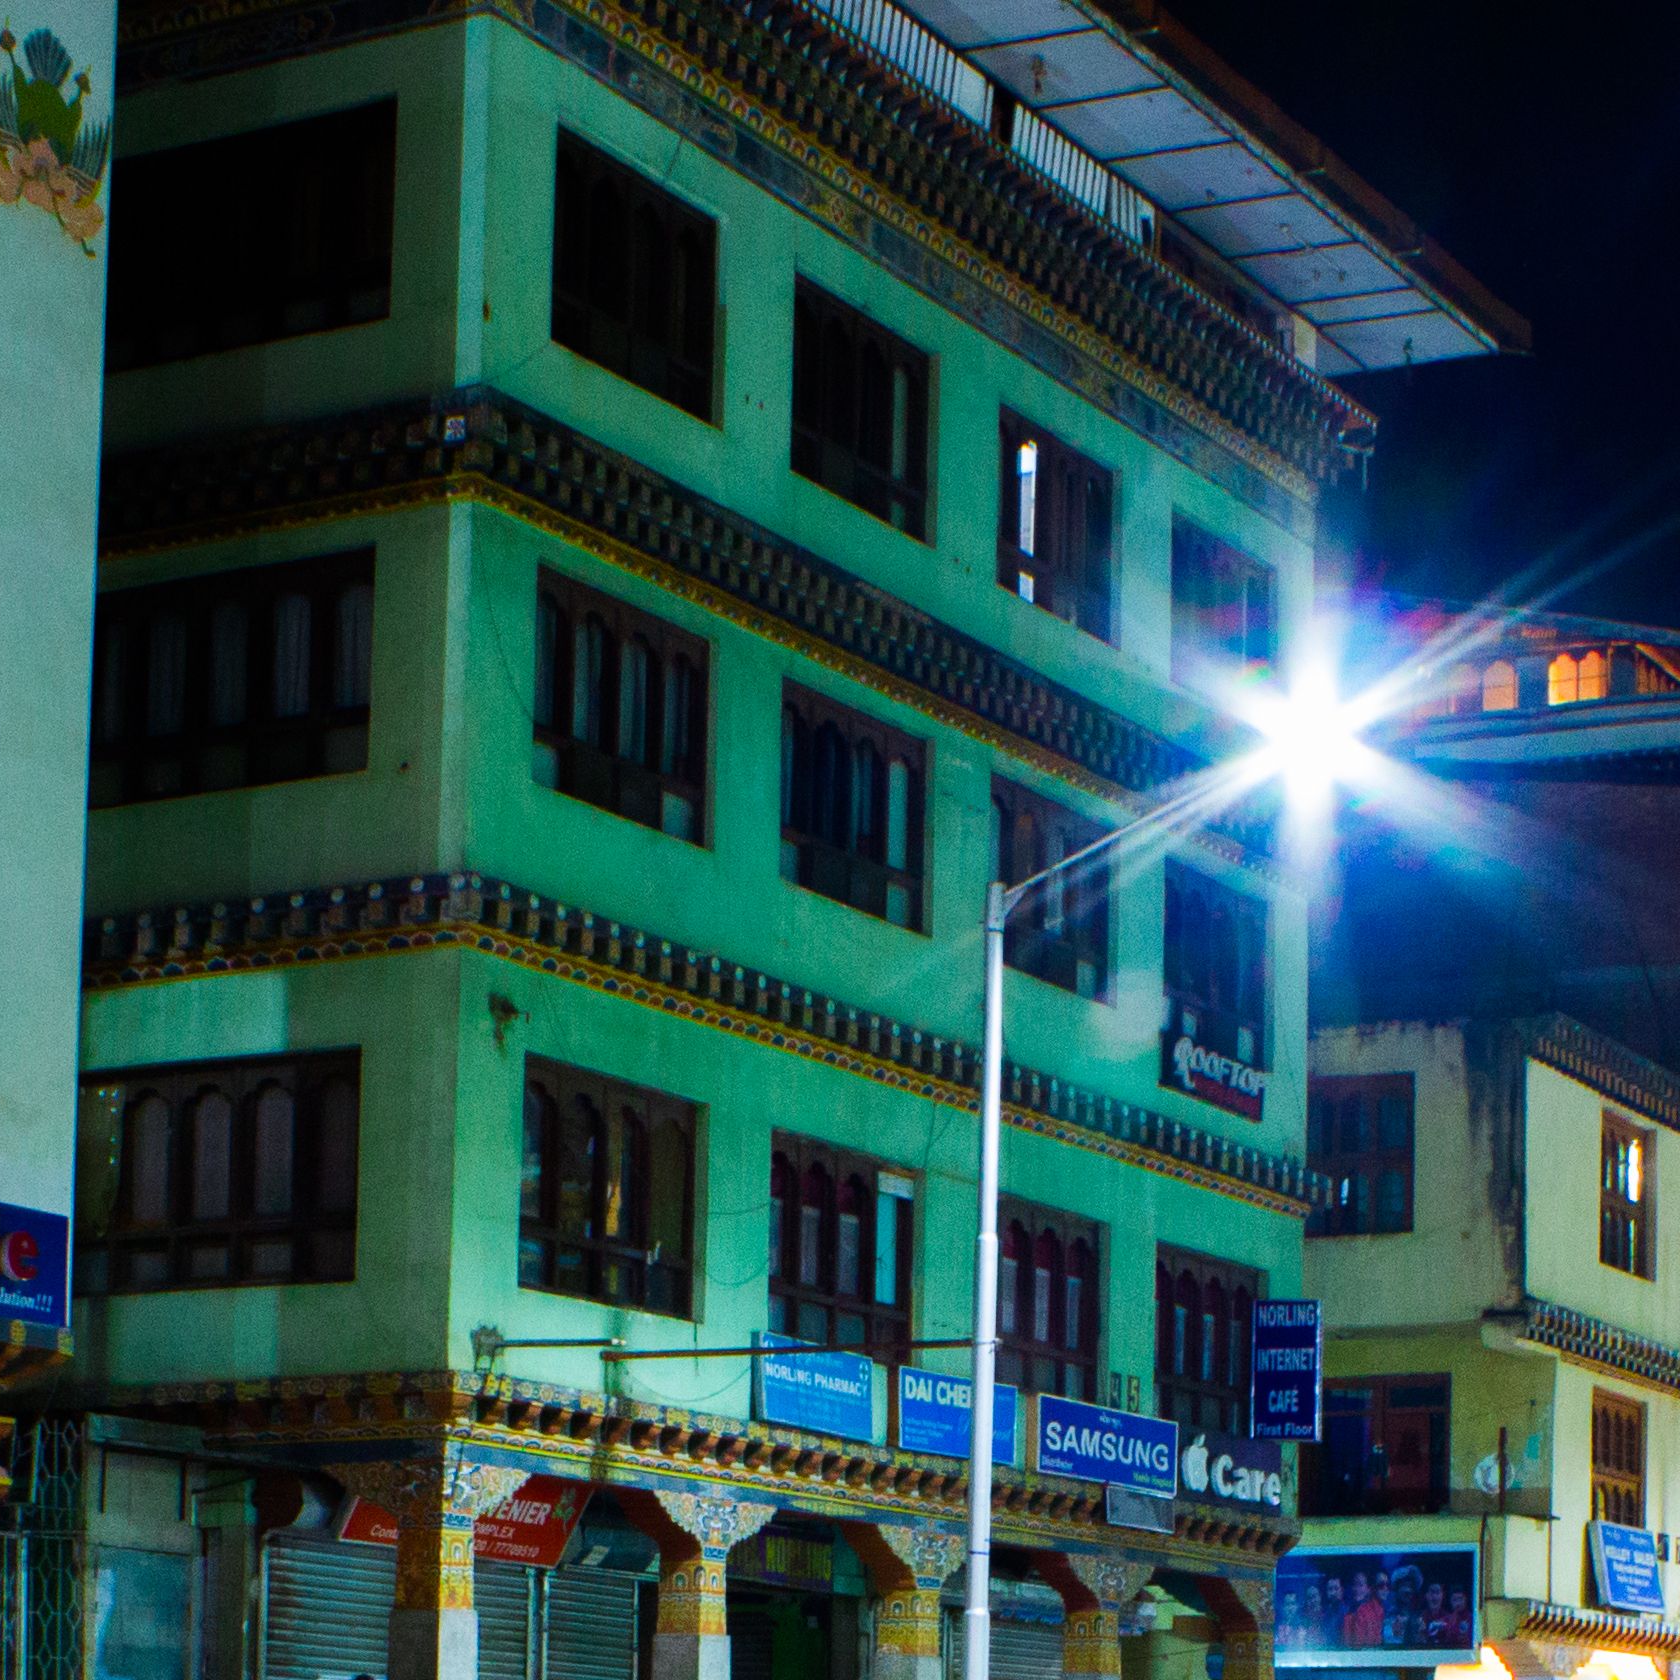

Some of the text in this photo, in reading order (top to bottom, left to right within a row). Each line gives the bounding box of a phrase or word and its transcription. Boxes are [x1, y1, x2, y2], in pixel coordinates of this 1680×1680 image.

[1258, 1304, 1315, 1327] NORLING
[1257, 1348, 1314, 1371] INTERNET
[765, 1362, 812, 1386] NORLING
[815, 1372, 868, 1398] PHARMACY
[905, 1375, 932, 1403] DAI
[1268, 1385, 1299, 1413] CAFÉ
[1045, 1421, 1169, 1472] SAMSUNG
[1211, 1454, 1282, 1506] Care
